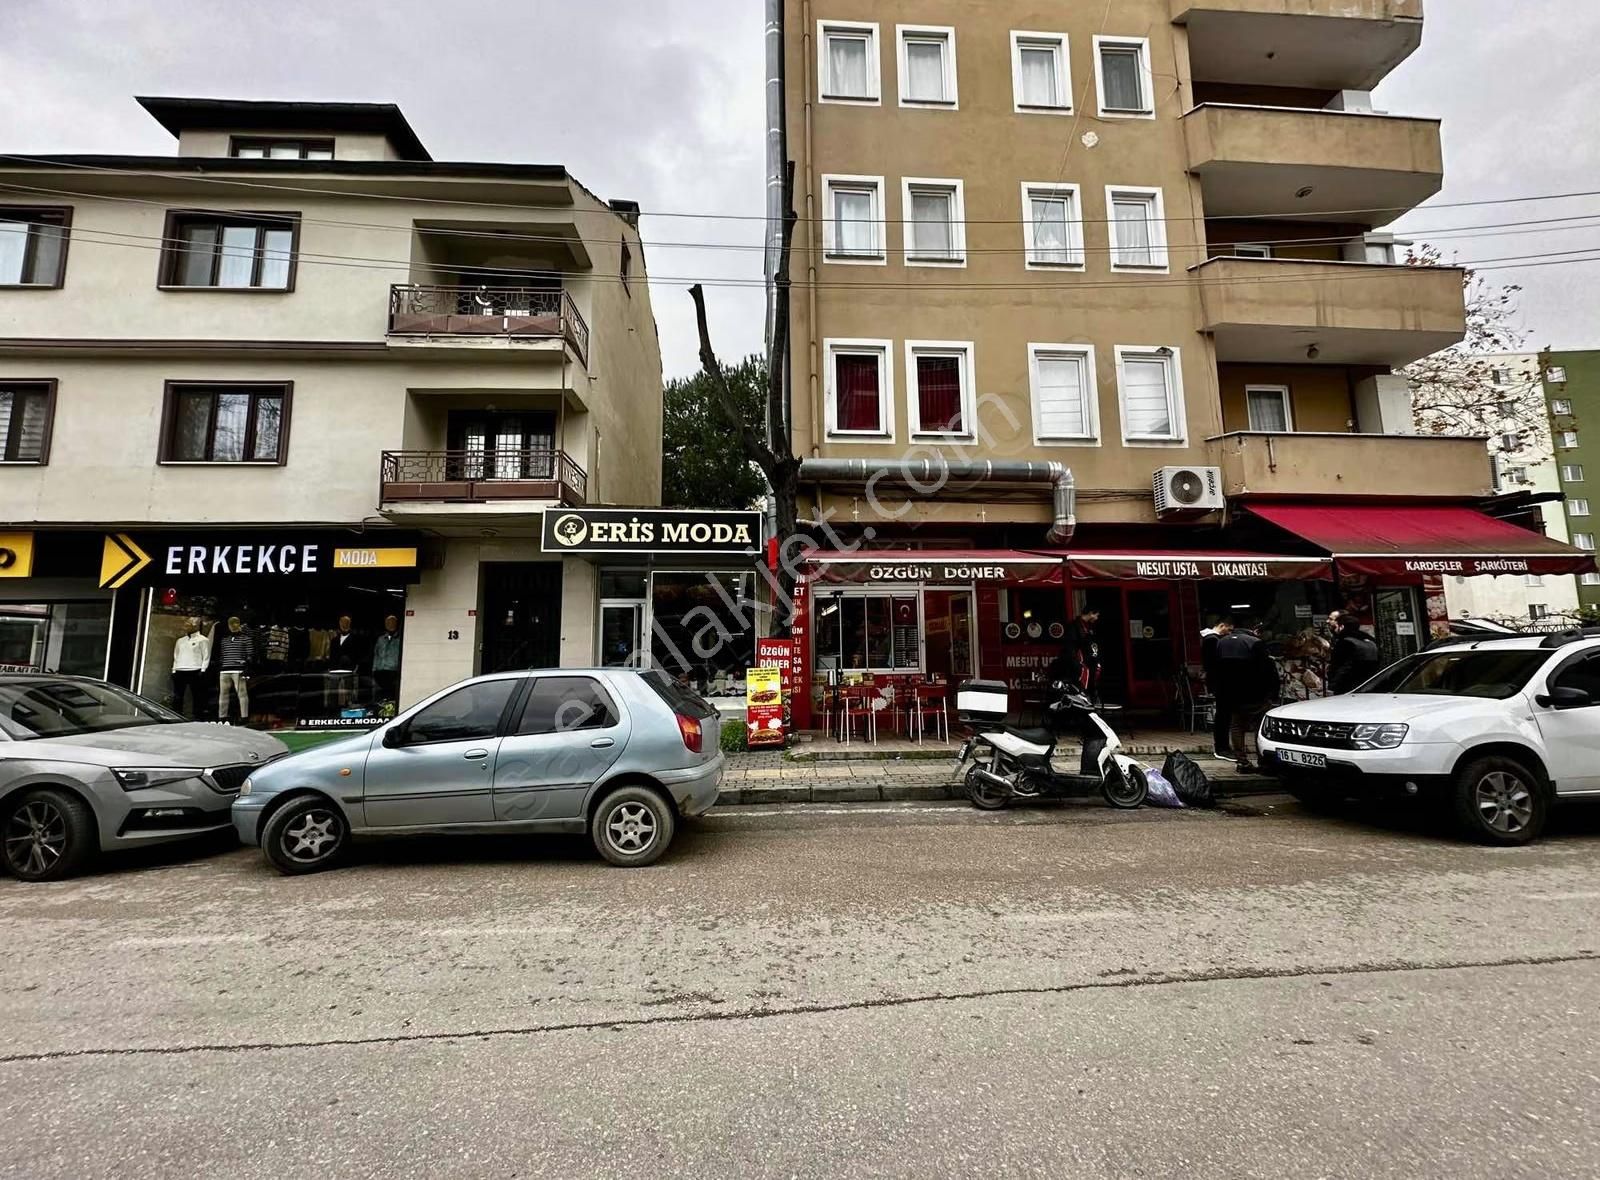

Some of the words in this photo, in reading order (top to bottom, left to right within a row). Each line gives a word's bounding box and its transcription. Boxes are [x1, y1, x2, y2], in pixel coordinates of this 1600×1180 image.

[589, 517, 655, 543] ERİS
[661, 523, 752, 543] MODA
[166, 545, 318, 575] ERKEKÇE
[340, 550, 377, 565] MODA
[1405, 560, 1463, 572] KARDEŞLER
[870, 564, 932, 579] ÖZGÜN
[944, 564, 1005, 579] DÖNER
[1136, 562, 1170, 576] MESUT
[1172, 562, 1199, 576] USTA
[1211, 562, 1268, 576] LOKANTASI
[447, 630, 459, 640] 13
[760, 645, 790, 656] ÖZGÜN
[760, 658, 790, 669] DÖNER
[1280, 750, 1289, 760] 16
[1291, 751, 1298, 763] L
[1301, 753, 1324, 766] 8226
